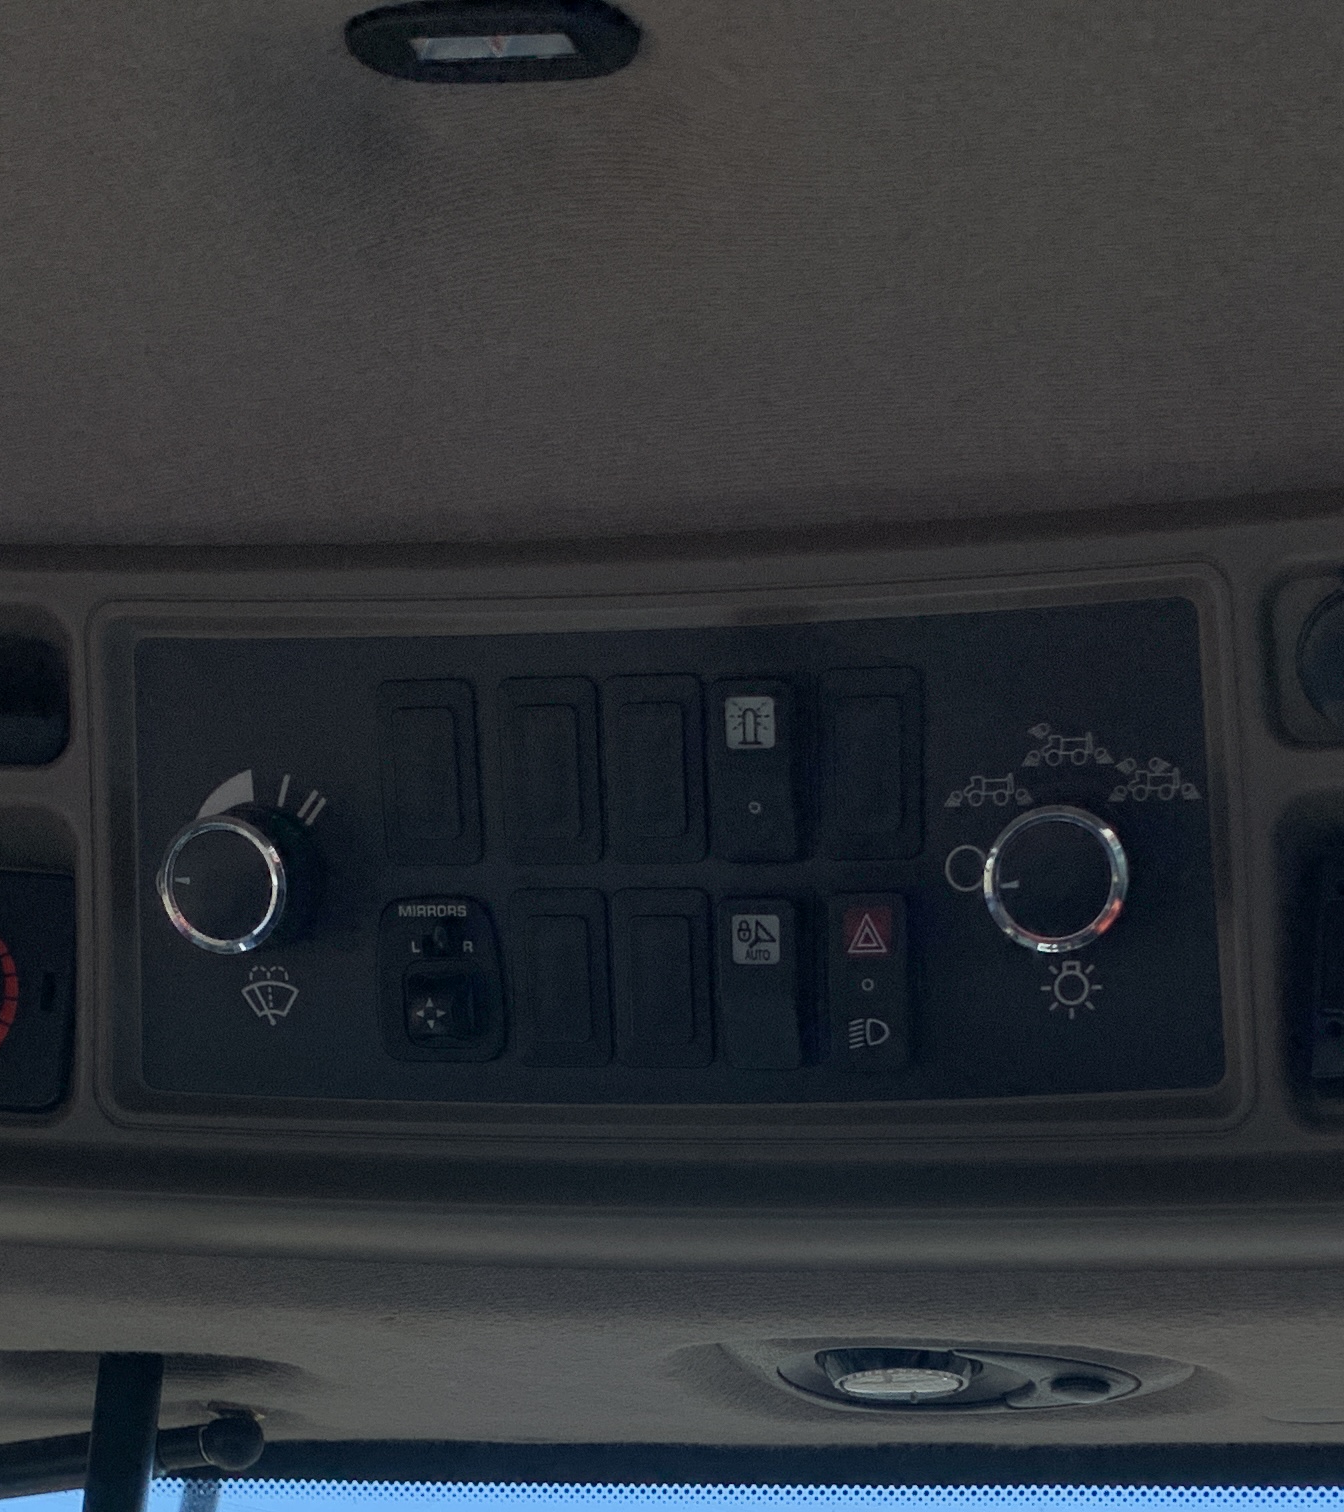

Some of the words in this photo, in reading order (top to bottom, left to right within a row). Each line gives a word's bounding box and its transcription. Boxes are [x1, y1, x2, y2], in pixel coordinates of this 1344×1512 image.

[398, 905, 467, 917] MIRRORS
[411, 941, 421, 953] L
[463, 940, 474, 953] R
[745, 949, 770, 961] AUTO
